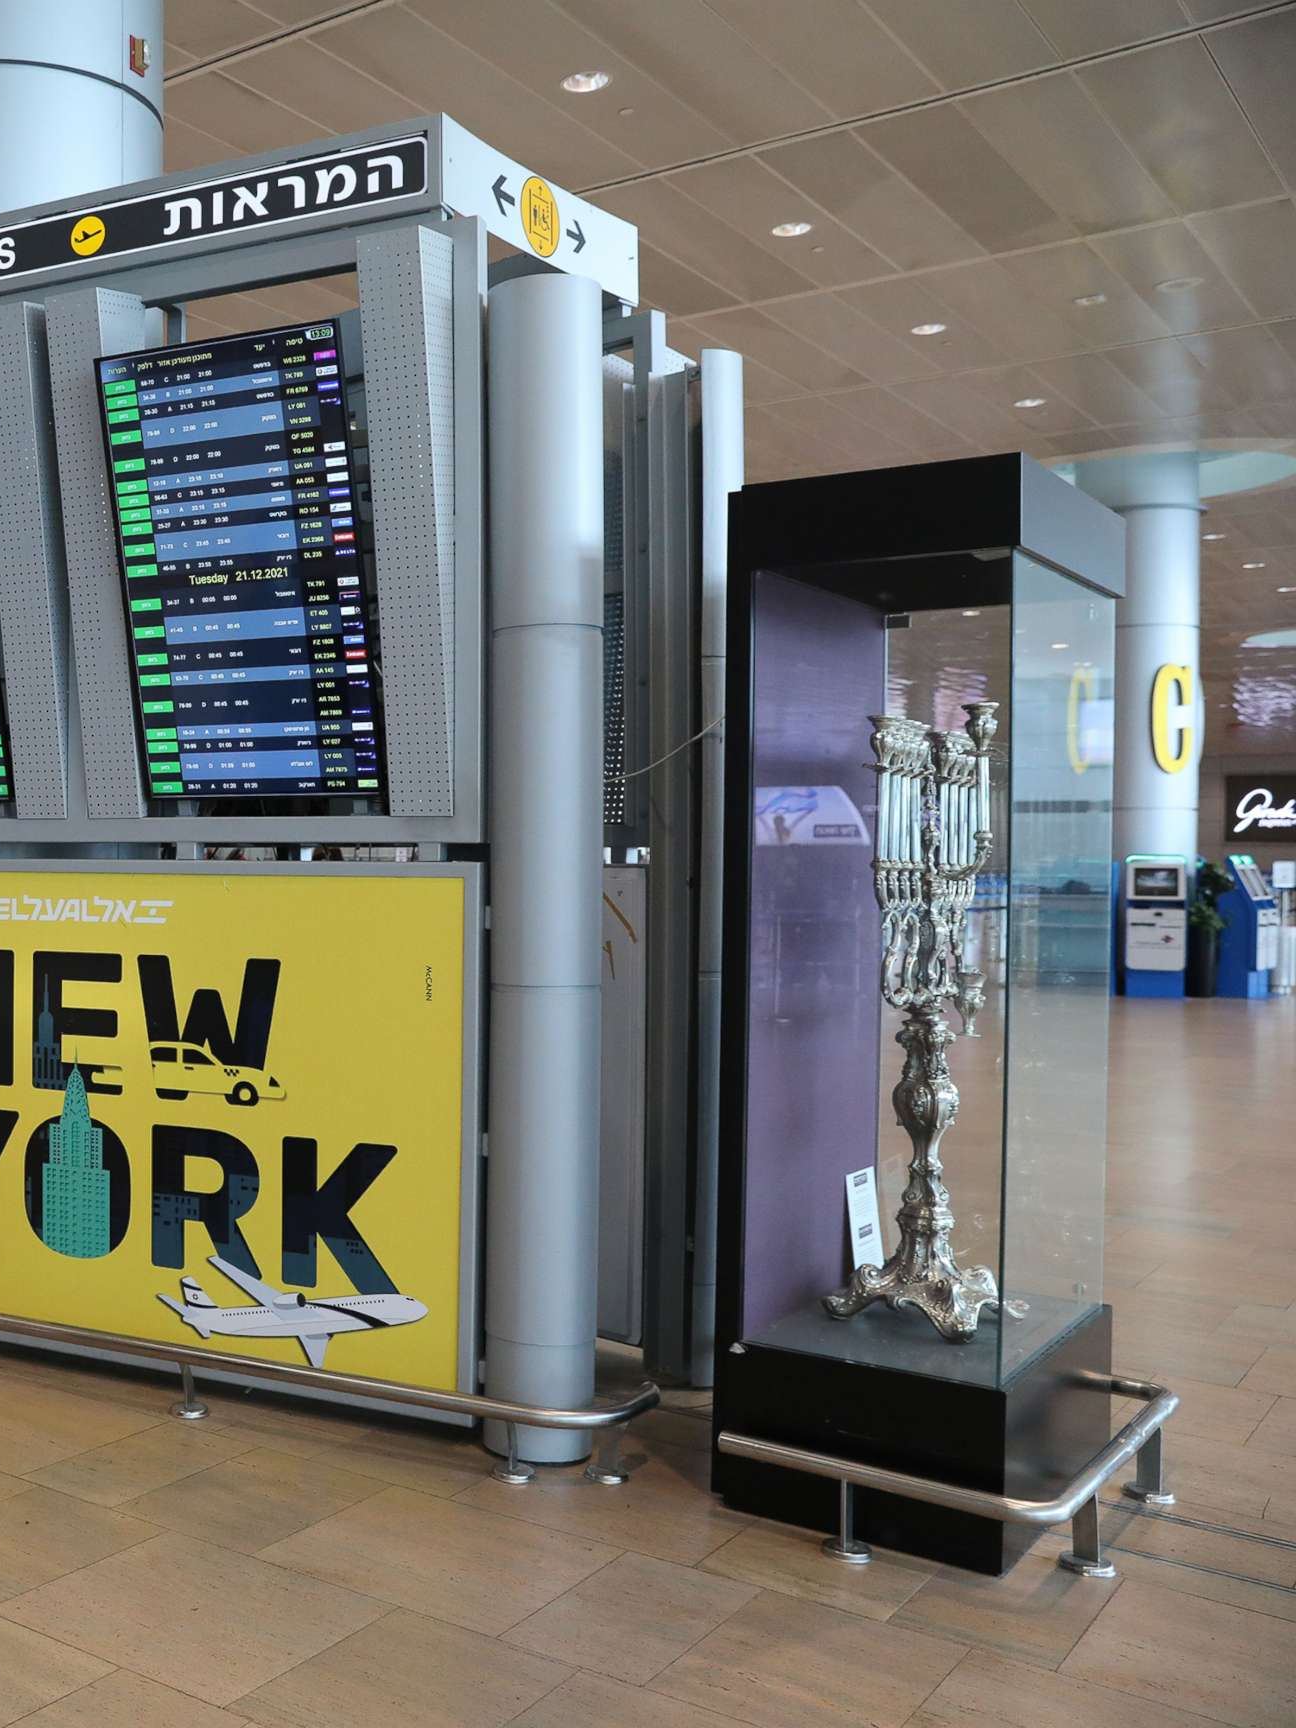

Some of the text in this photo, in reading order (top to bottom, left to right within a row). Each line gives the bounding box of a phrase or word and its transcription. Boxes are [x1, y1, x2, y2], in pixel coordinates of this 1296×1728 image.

[163, 155, 406, 235] המראות
[311, 328, 330, 340] 13:09
[136, 361, 152, 371] דלפק
[253, 343, 265, 351] יעד
[285, 337, 303, 345] טיסה
[176, 373, 190, 381] 21:00
[197, 369, 212, 377] 21:00
[188, 567, 287, 584] Tuesday 21.12.2021
[1150, 662, 1194, 775] C
[424, 964, 434, 1002] McCANN
